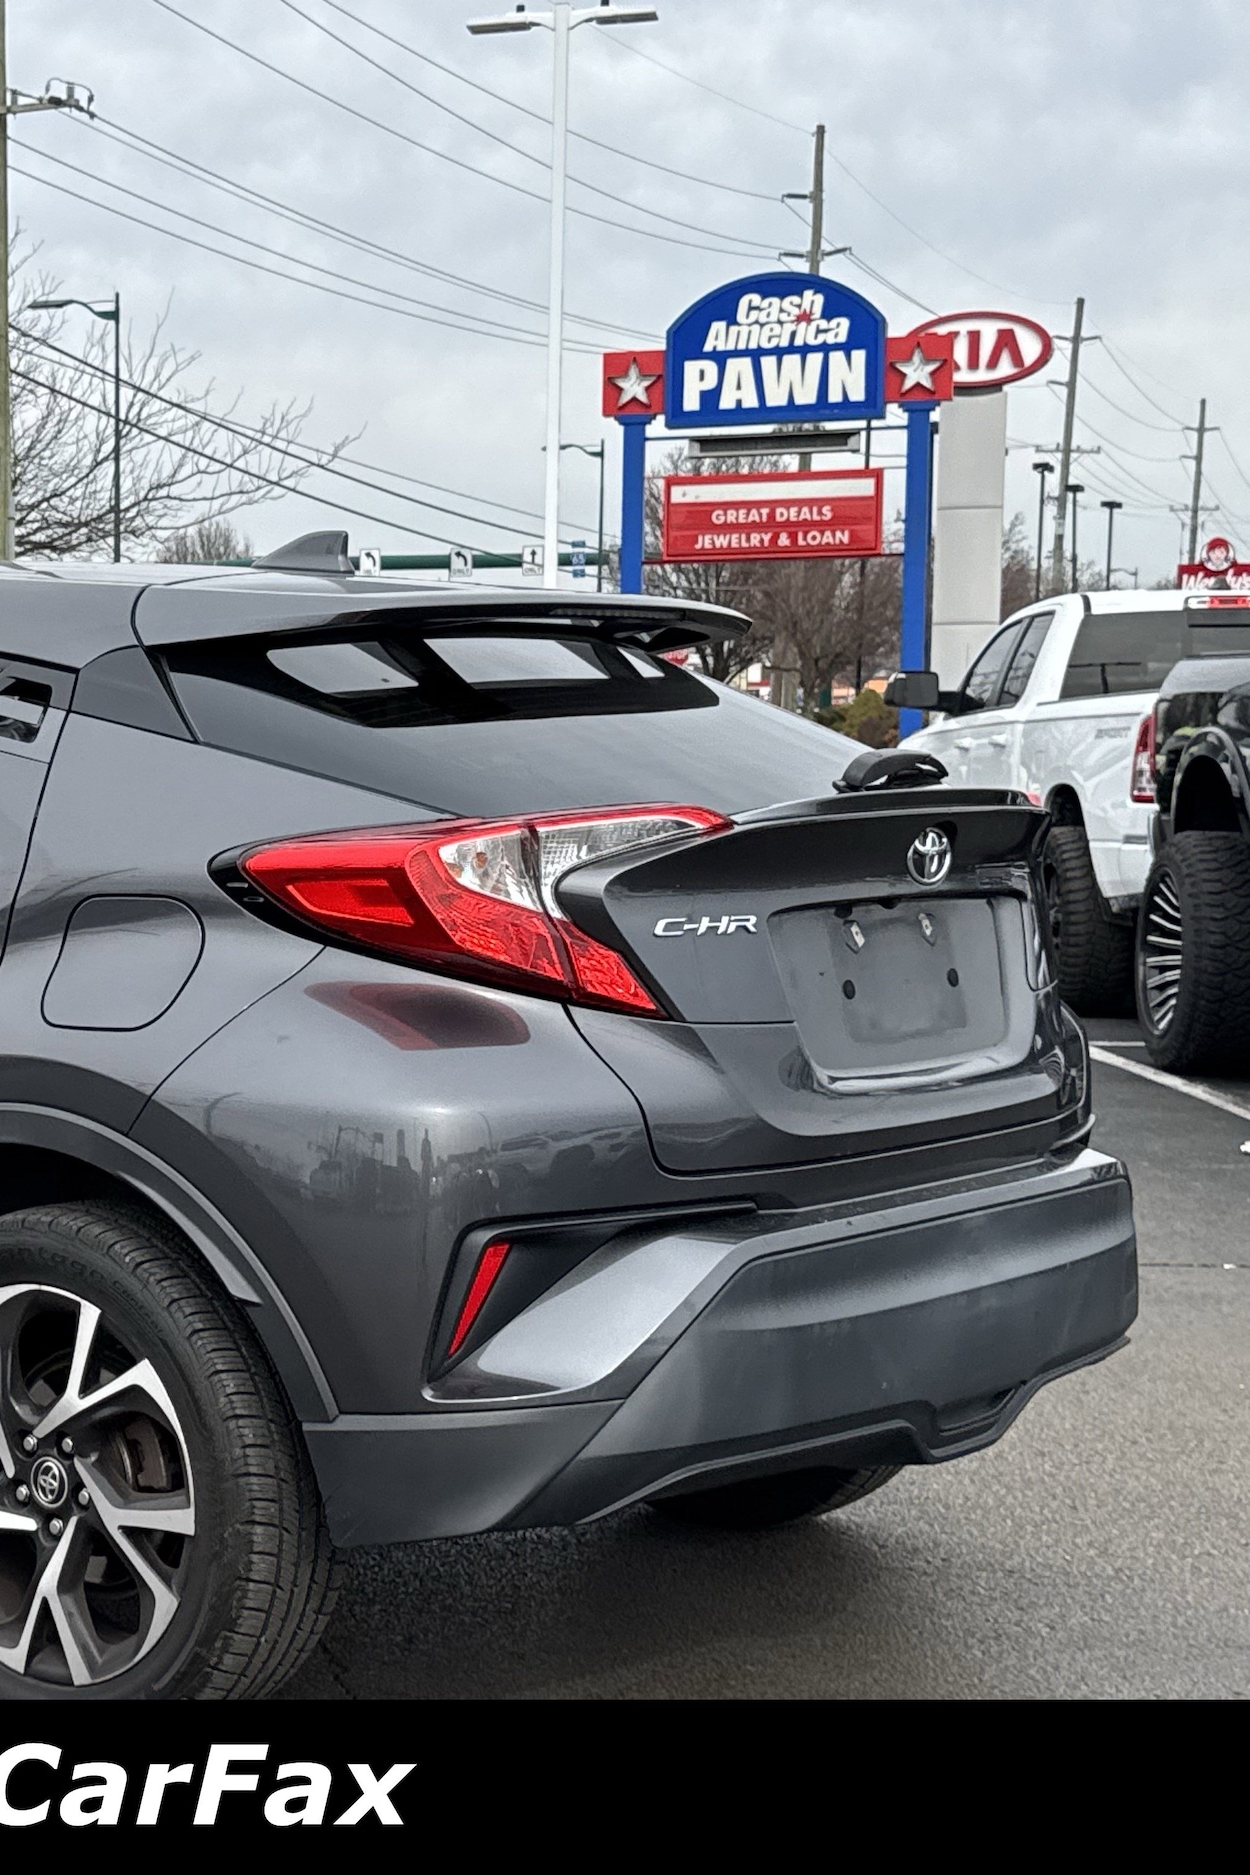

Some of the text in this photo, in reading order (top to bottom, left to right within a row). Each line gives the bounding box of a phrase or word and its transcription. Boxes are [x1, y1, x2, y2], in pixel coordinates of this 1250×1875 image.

[736, 288, 824, 325] Cash
[702, 317, 850, 352] America
[682, 349, 867, 412] PAWN
[711, 505, 834, 525] GREAT DEALS
[694, 530, 849, 550] JEWELRY & LOAN
[653, 915, 758, 937] C-HR
